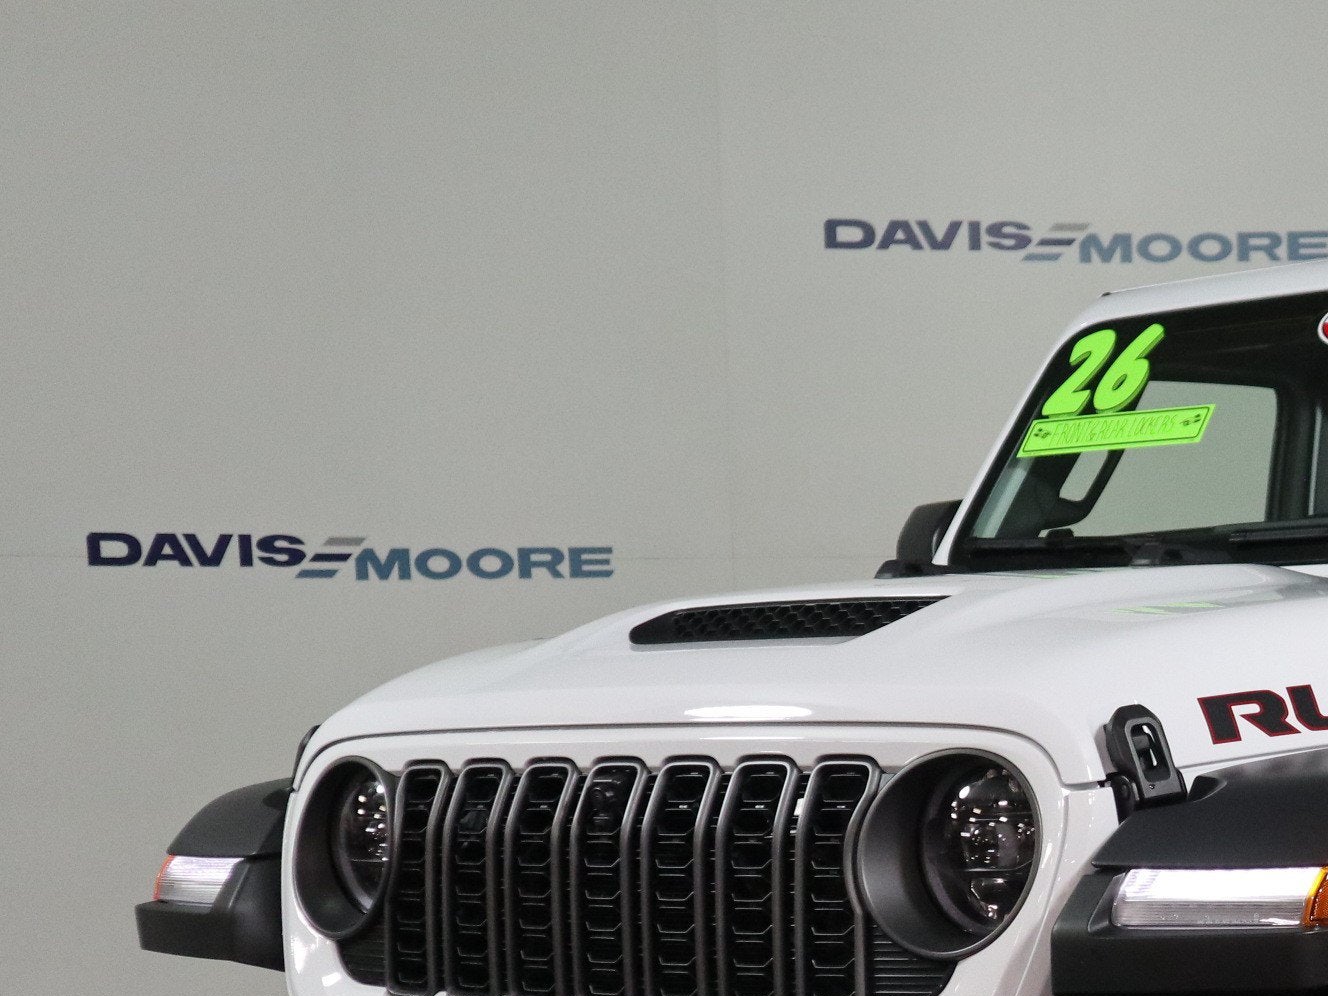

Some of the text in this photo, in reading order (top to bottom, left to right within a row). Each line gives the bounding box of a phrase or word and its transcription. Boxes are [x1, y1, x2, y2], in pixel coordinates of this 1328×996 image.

[823, 218, 1032, 251] DAVIS
[1041, 323, 1165, 418] 26
[86, 532, 615, 581] DAVIS MOORE
